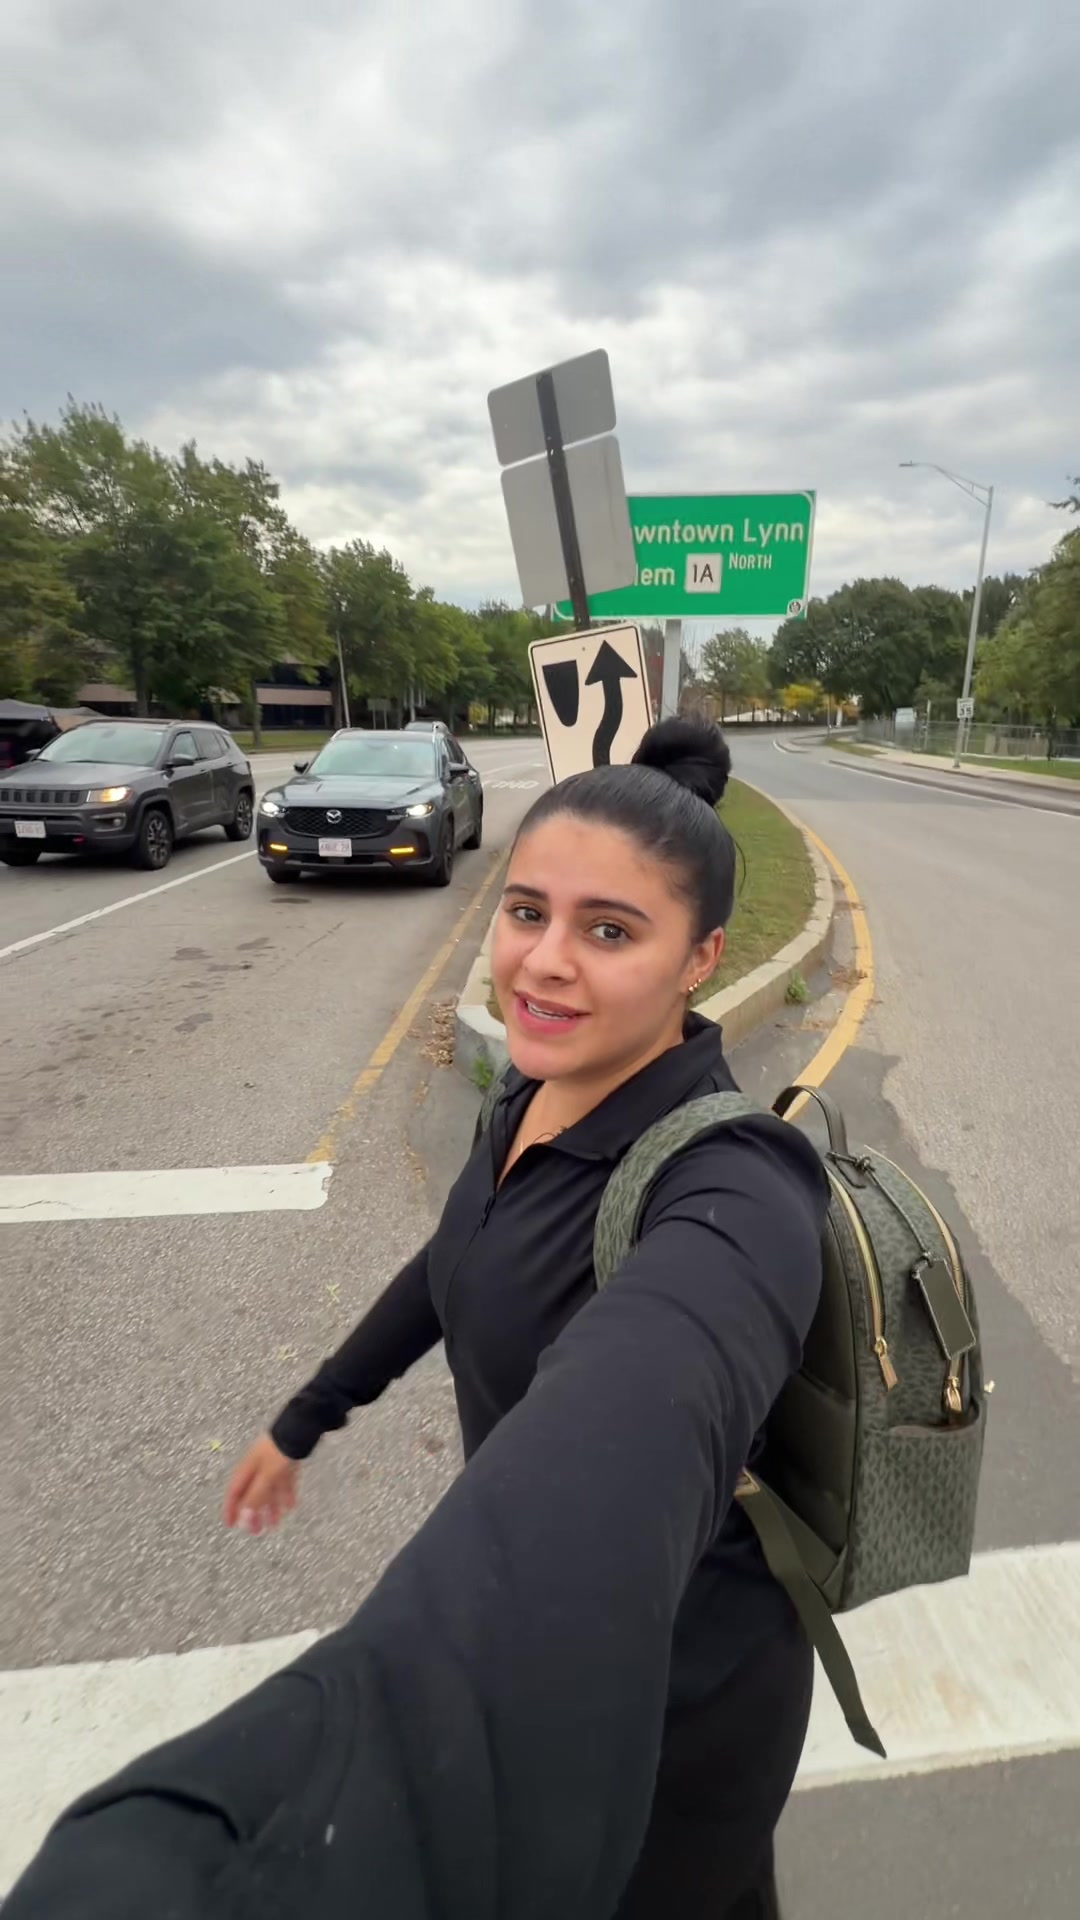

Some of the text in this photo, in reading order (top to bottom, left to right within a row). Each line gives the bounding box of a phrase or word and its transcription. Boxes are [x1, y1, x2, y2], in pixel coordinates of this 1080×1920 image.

[634, 518, 804, 547] wntown Lynn
[729, 553, 772, 569] NORTH
[634, 563, 676, 586] lem
[693, 563, 714, 584] 1A
